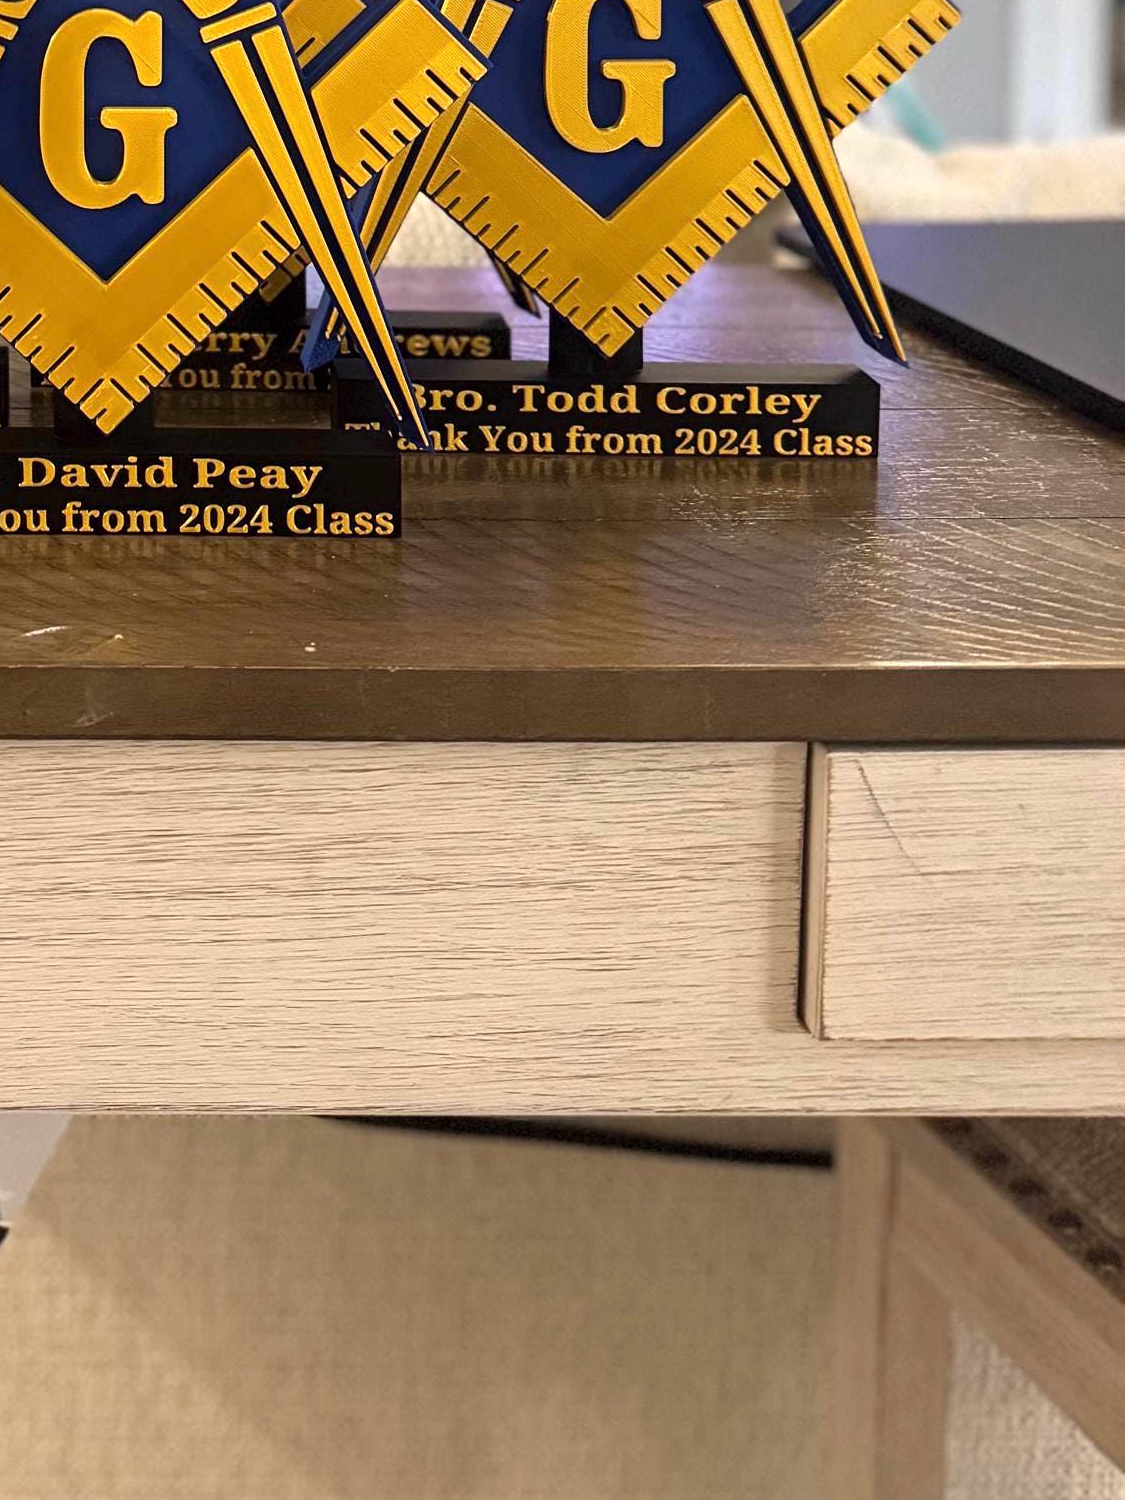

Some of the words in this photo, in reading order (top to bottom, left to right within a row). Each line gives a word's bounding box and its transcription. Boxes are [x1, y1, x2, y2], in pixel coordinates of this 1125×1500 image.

[39, 8, 178, 210] G
[159, 367, 221, 389] ou
[230, 362, 317, 390] from
[512, 384, 642, 414] Todd
[655, 386, 822, 422] Corley
[478, 425, 554, 453] You
[566, 425, 664, 455] from
[675, 428, 762, 456] 2024
[773, 428, 873, 457] Class
[18, 456, 178, 489] David
[194, 457, 324, 498] Peay
[61, 500, 167, 534] from
[179, 503, 274, 535] 2024
[286, 503, 395, 536] Class
